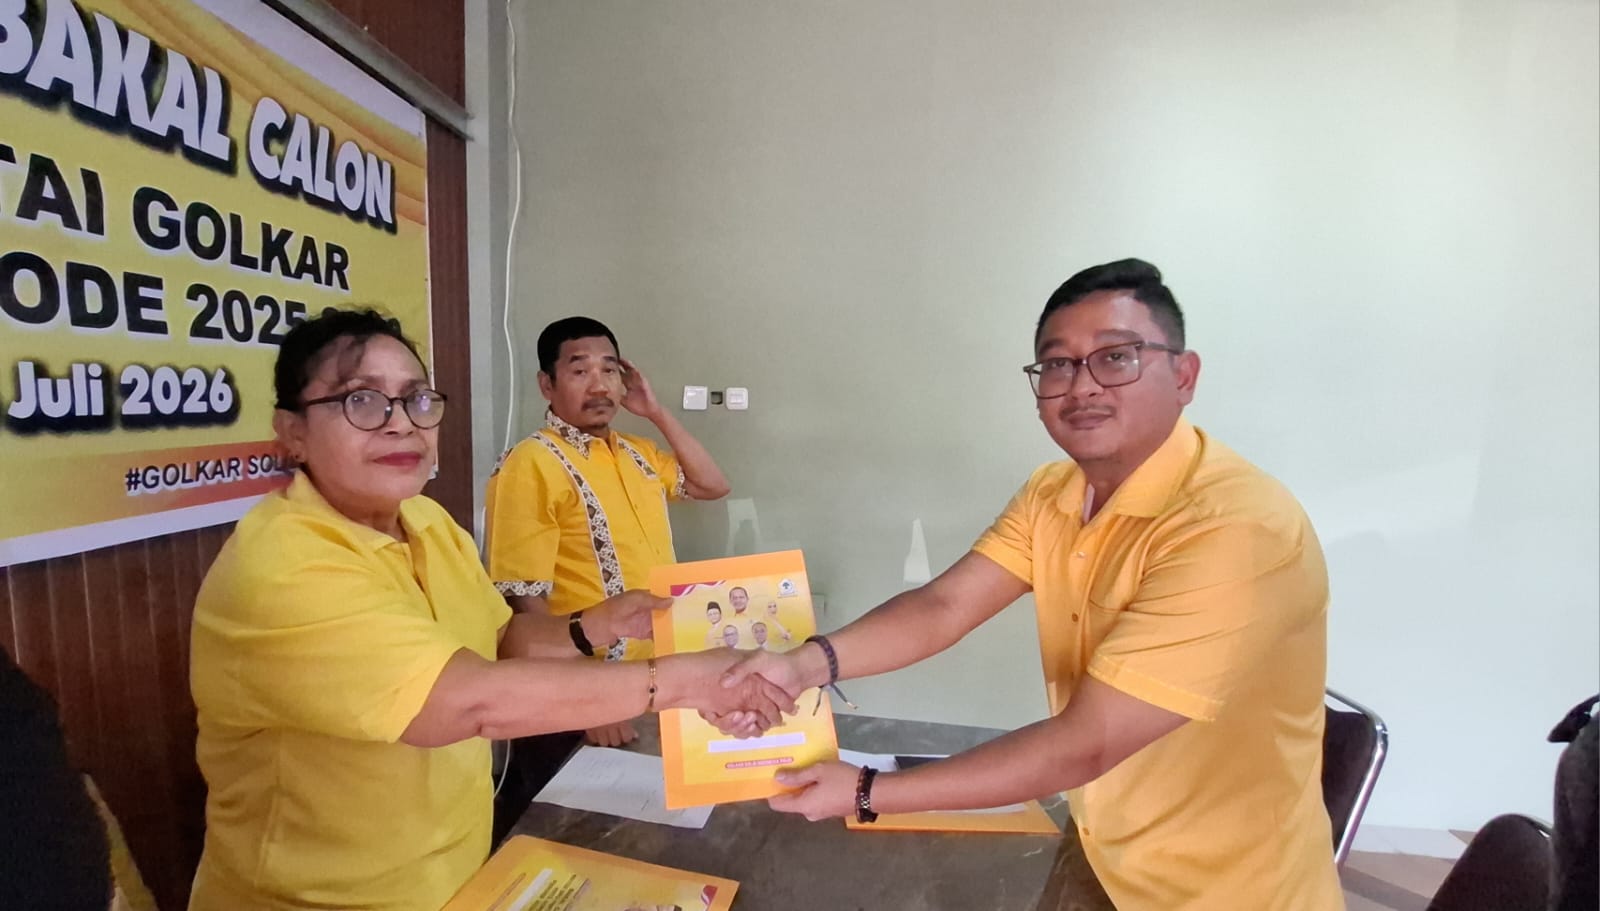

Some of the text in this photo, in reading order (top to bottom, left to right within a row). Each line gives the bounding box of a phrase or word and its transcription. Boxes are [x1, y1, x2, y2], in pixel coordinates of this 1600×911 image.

[249, 97, 393, 224] CALON
[133, 187, 350, 290] GOLKAR
[8, 361, 233, 418] Juli 2026
[125, 457, 241, 491] #GOLKAR
